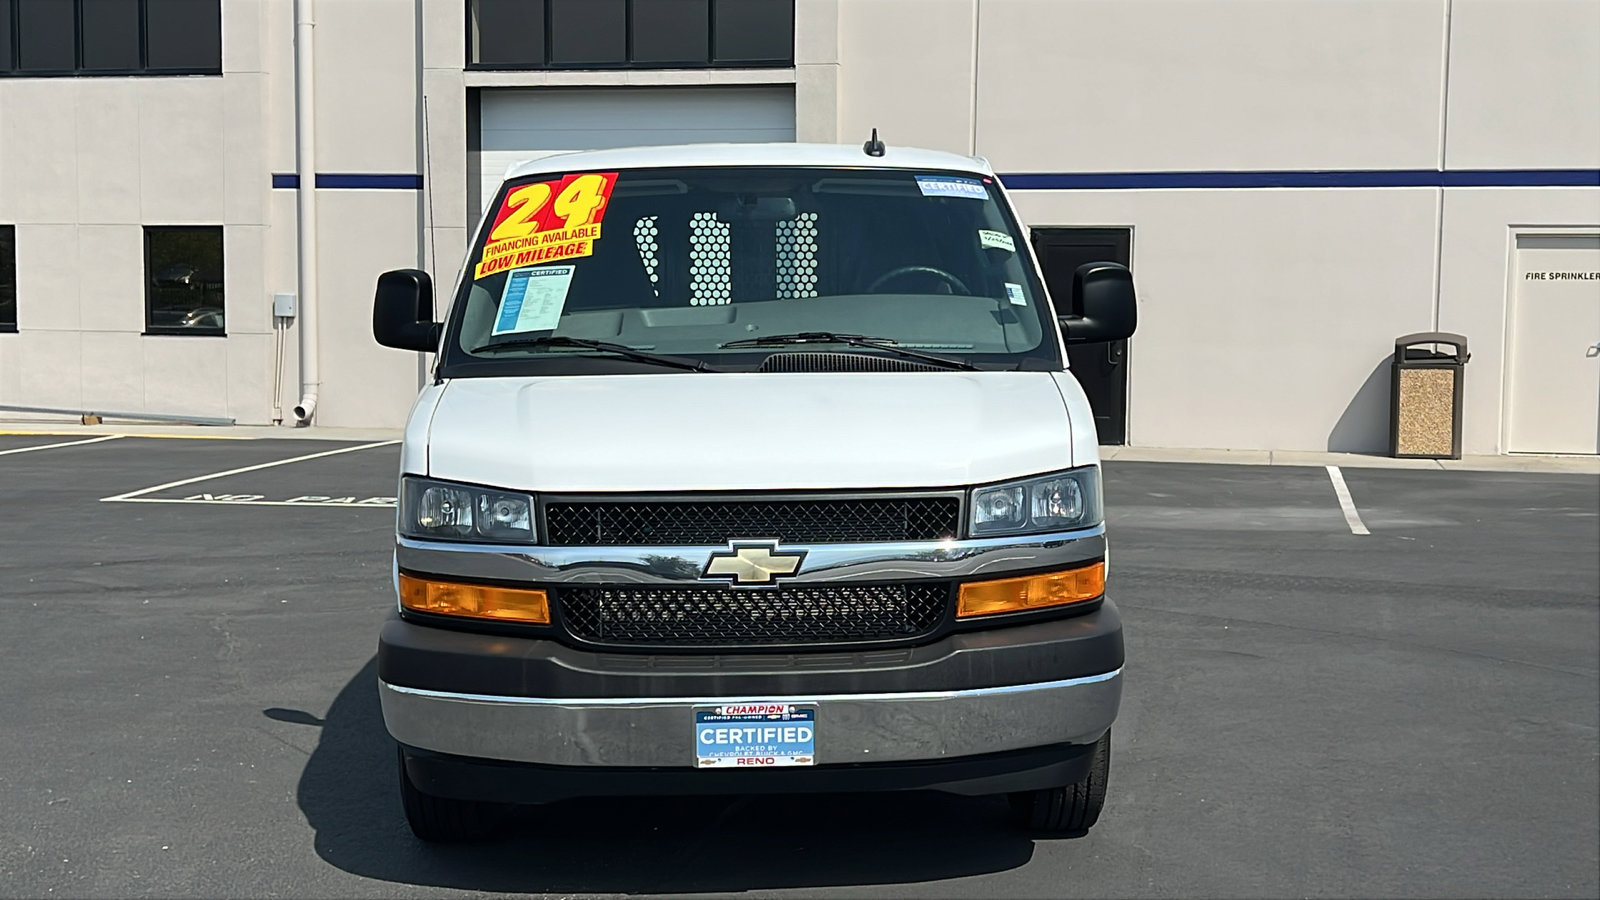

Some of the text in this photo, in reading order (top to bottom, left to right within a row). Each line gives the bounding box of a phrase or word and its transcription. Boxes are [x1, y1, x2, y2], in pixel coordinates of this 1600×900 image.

[921, 182, 983, 194] CERTIFIED
[491, 174, 606, 241] 24
[485, 226, 598, 258] FINANCING AVAILABLE
[480, 241, 588, 275] LOW MILEAGE
[1525, 272, 1600, 280] FIRE SPRINKLER
[184, 493, 264, 501] NO
[726, 705, 784, 714] CHAMPION
[700, 727, 813, 745] CERTIFIED
[736, 757, 775, 765] RENO
